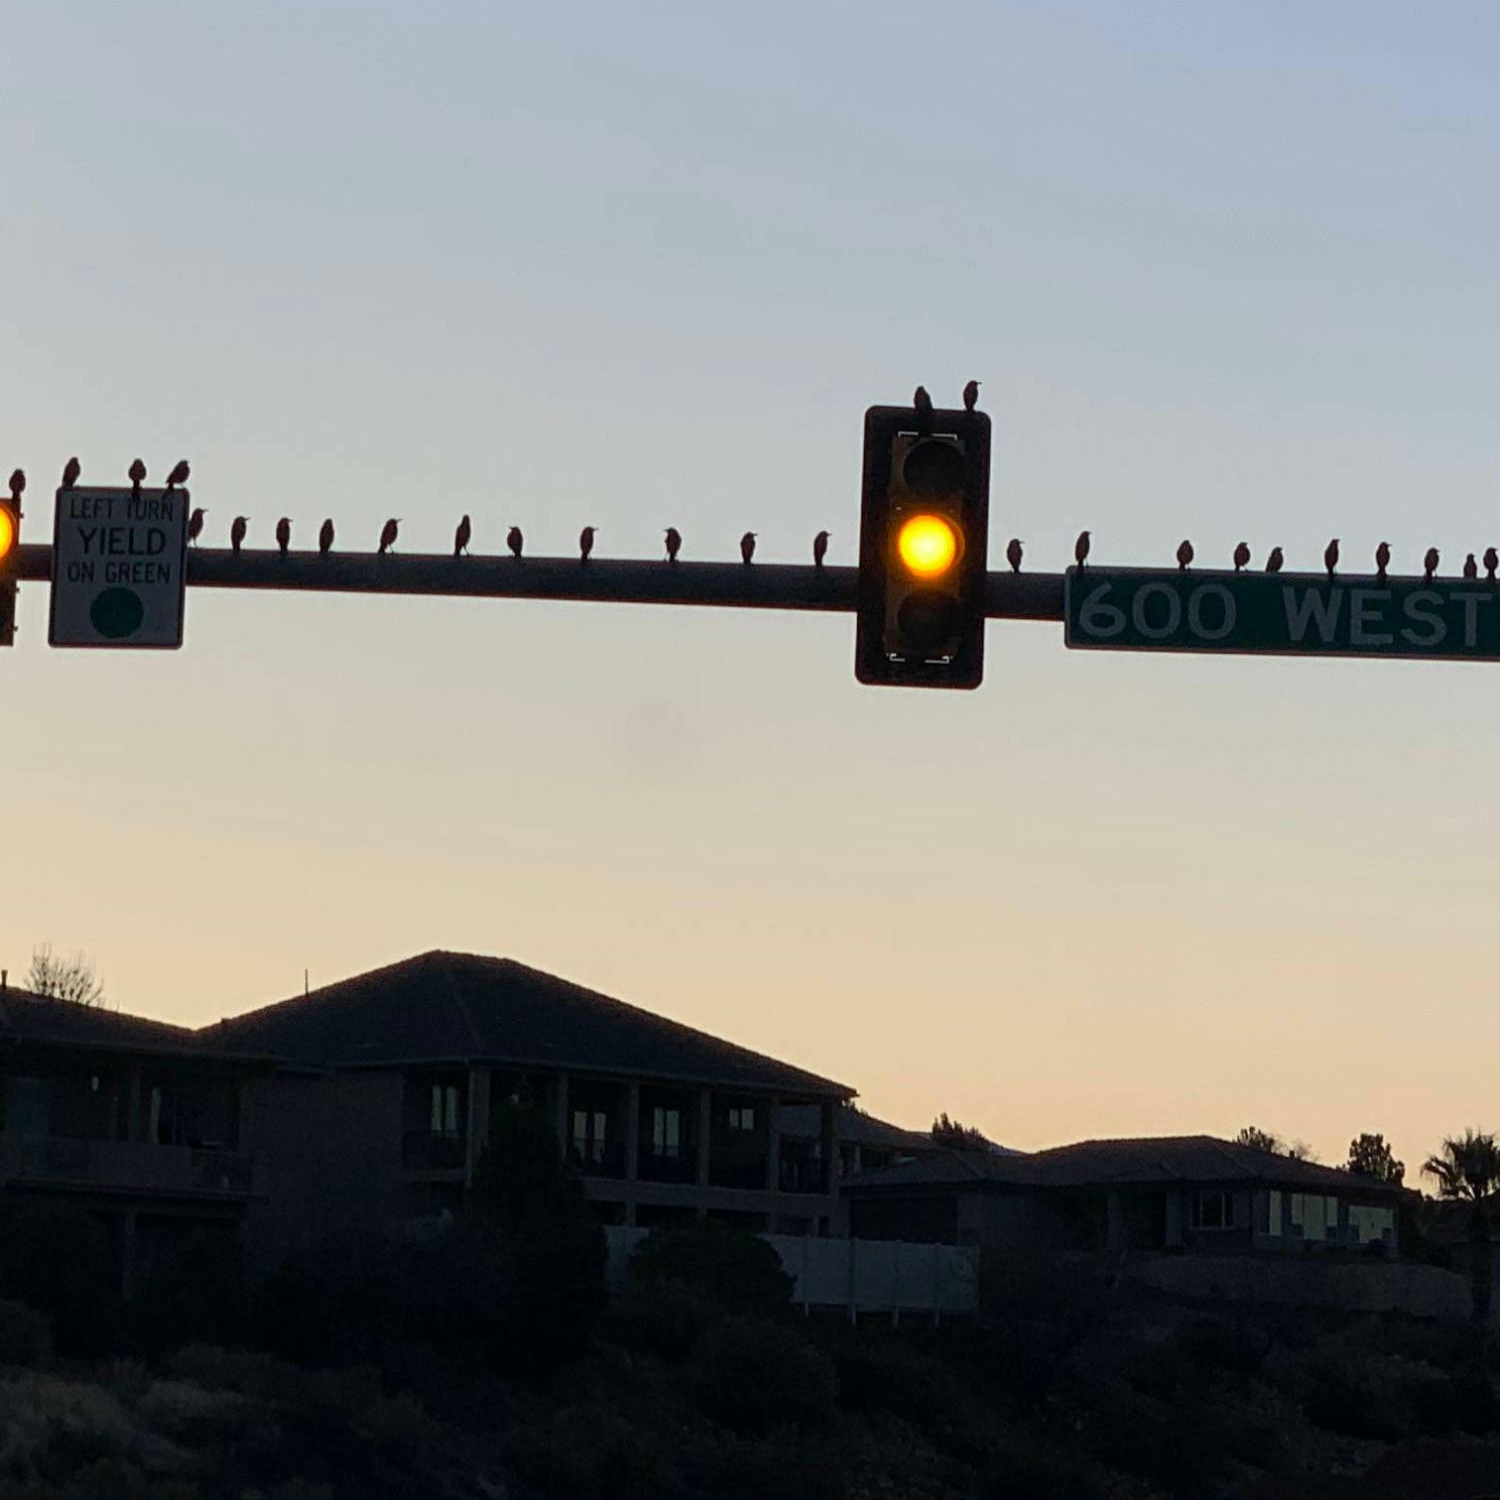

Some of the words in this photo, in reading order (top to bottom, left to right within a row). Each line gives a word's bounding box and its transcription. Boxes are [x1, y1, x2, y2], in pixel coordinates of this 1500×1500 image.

[70, 497, 113, 519] LEFT
[127, 498, 173, 520] TURN
[78, 527, 166, 556] YIELD
[68, 561, 94, 582] ON
[105, 562, 171, 583] GREEN
[1078, 581, 1238, 640] 600
[1281, 585, 1494, 648] WEST
